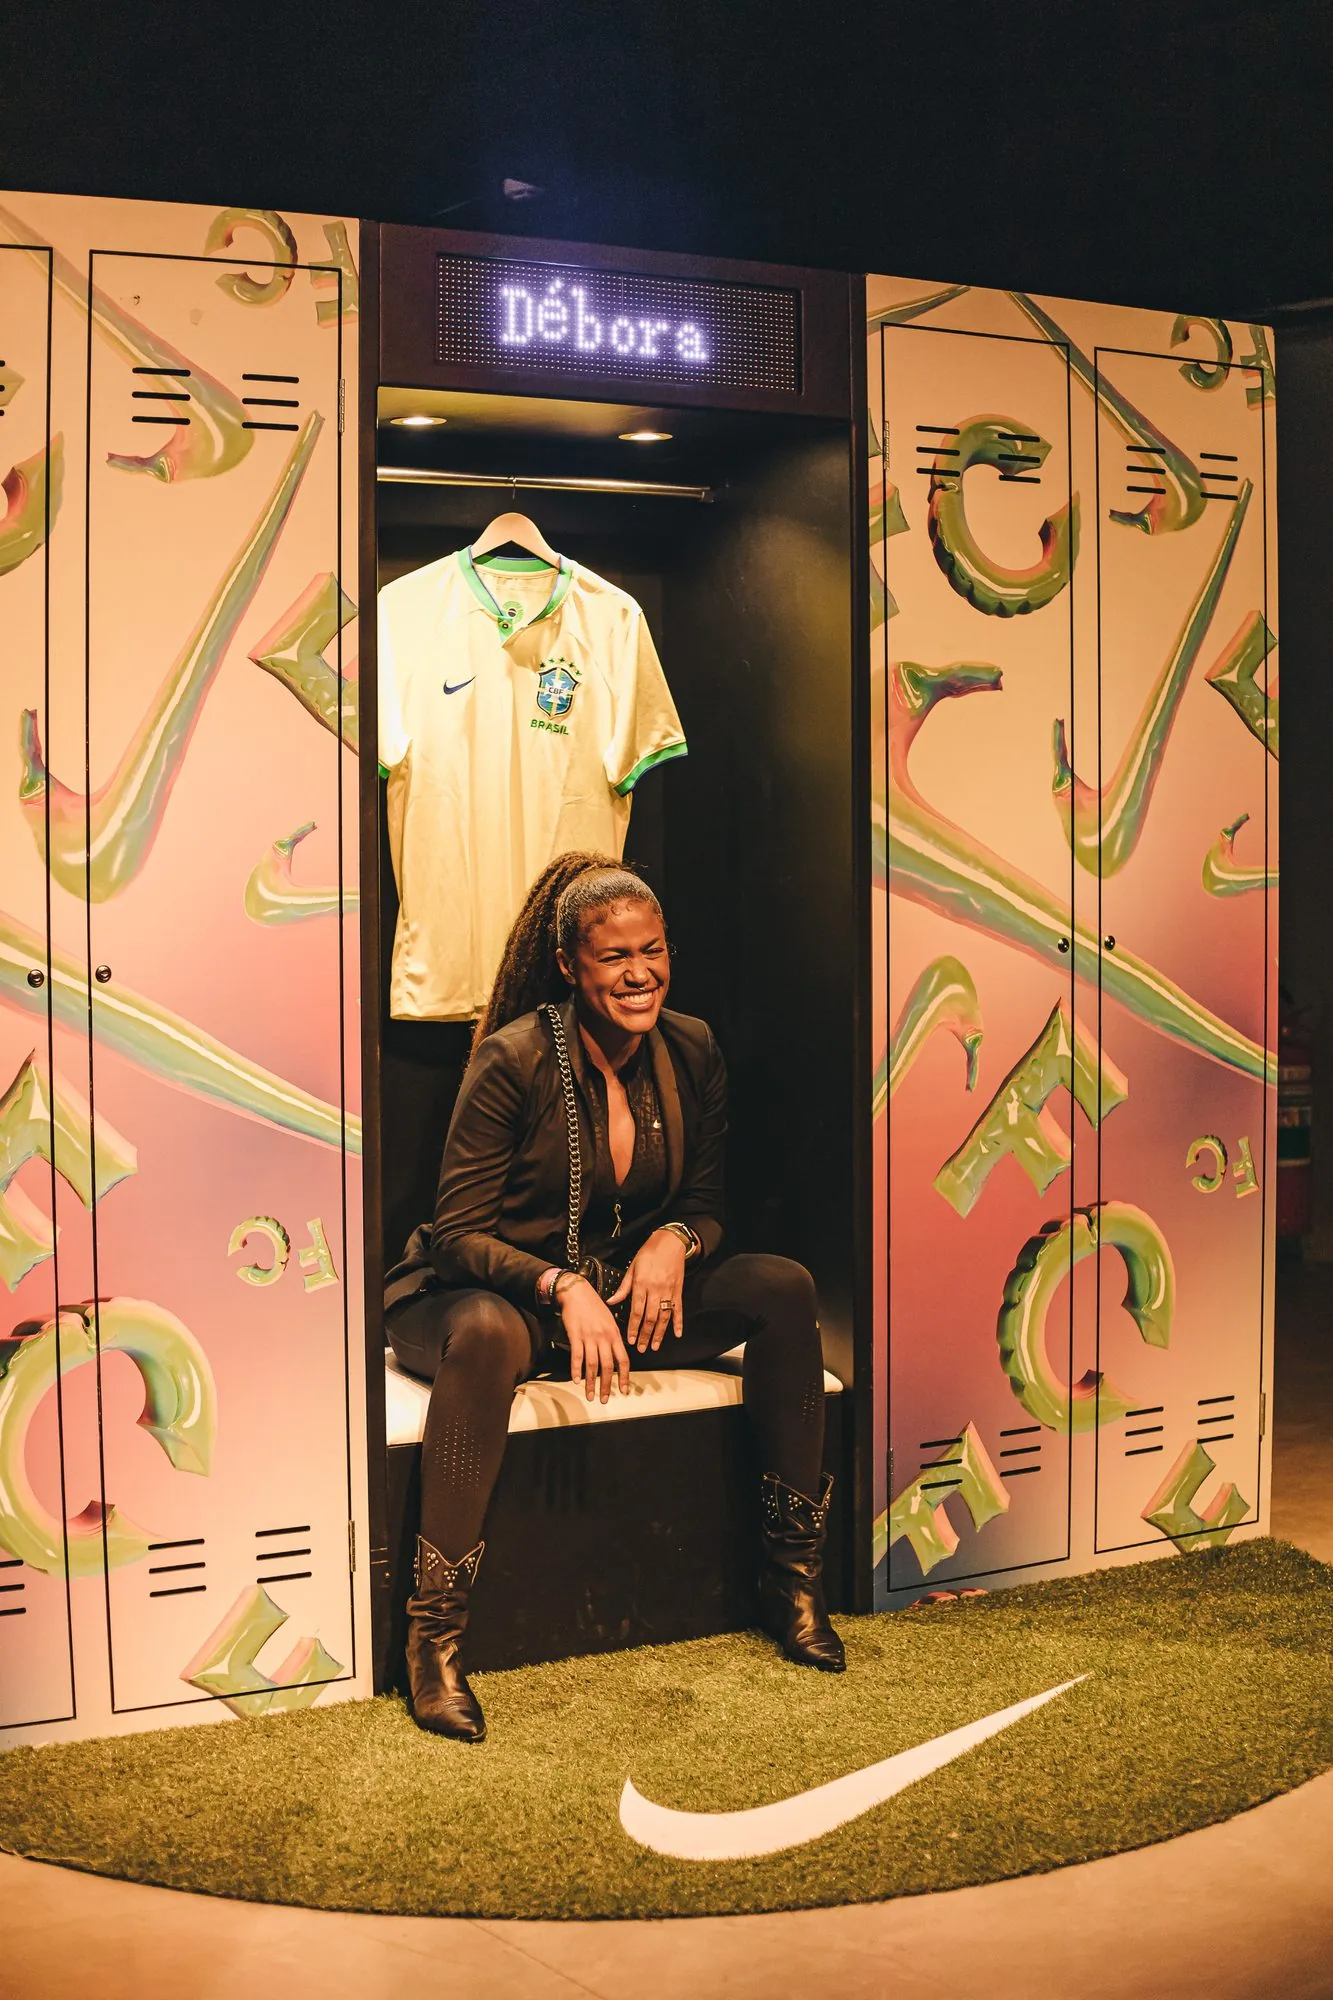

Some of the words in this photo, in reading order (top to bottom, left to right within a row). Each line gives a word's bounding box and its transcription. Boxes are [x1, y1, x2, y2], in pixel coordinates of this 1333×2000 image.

[500, 278, 708, 364] Débora
[548, 687, 564, 695] CBF
[530, 719, 569, 735] BRASIL
